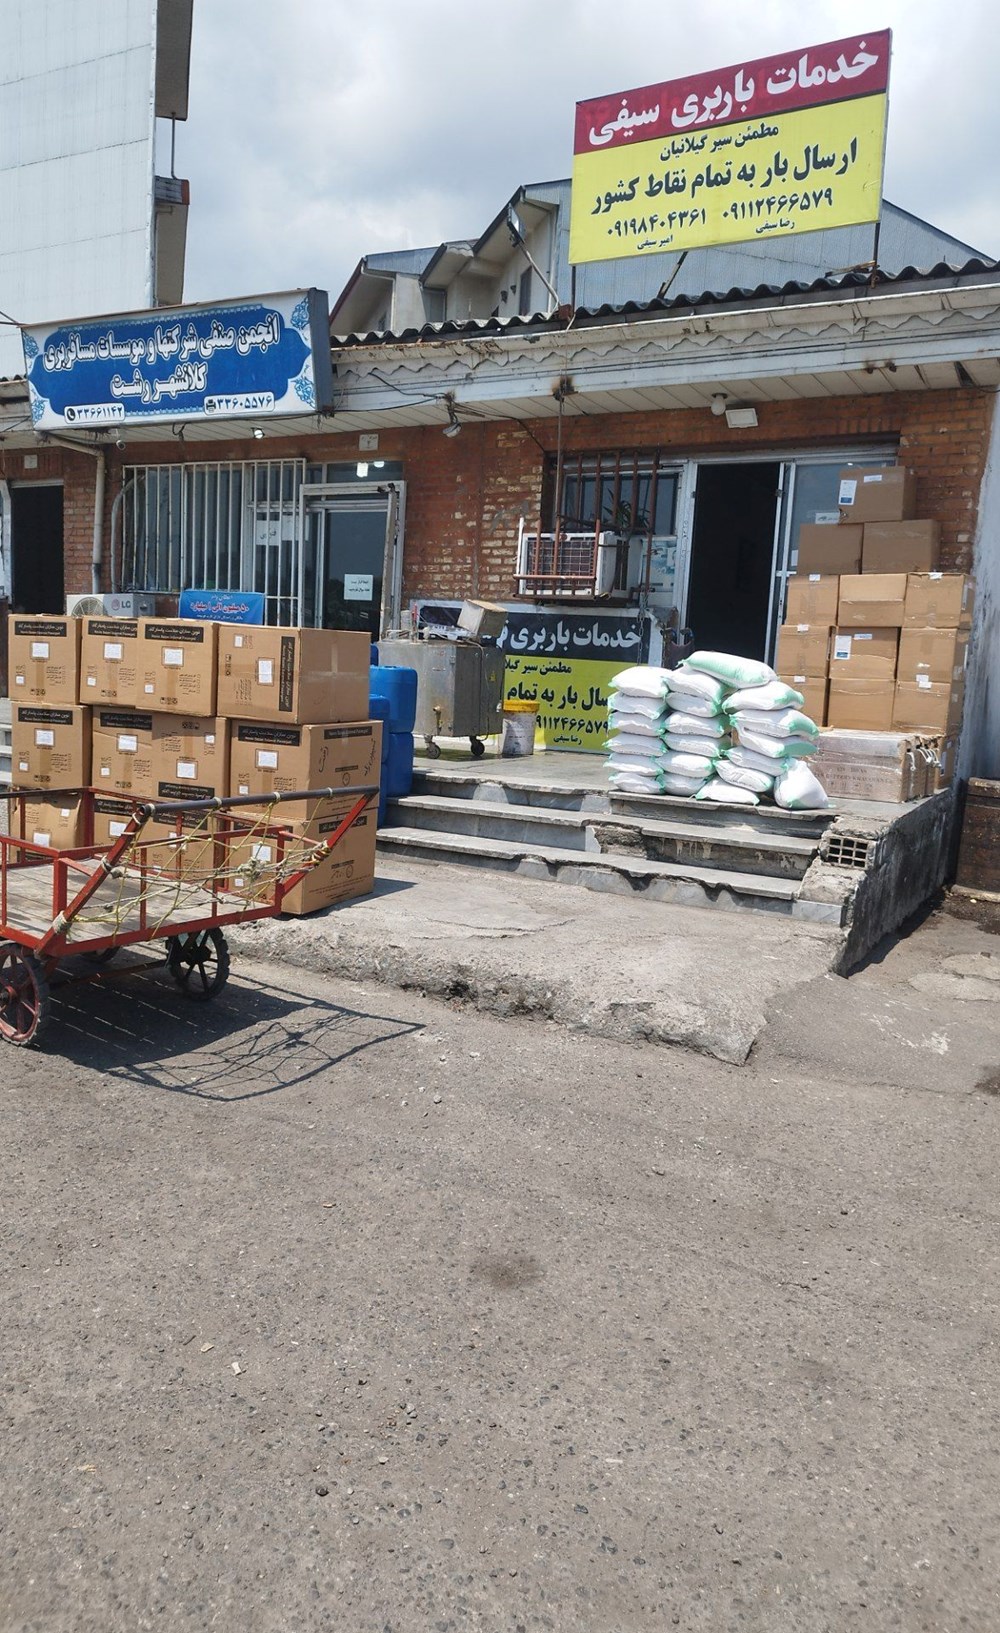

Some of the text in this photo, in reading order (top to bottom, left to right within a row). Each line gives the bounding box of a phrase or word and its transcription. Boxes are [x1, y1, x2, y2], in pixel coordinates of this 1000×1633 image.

[589, 41, 879, 145] خدمات باربری سیفی
[659, 122, 779, 161] مطمئن سیر گیلانیان
[591, 138, 857, 215] ارسال بار به تمام نقاط کشور
[722, 188, 832, 219] ۰۹۱۱۲۴۶۶۵۷۹
[607, 209, 706, 237] ۰۹۱۹۸۴۰۴۳۶۱
[755, 217, 796, 233] رضا سیفی
[97, 330, 145, 365] موسسات
[200, 320, 235, 359] صنفی
[238, 314, 280, 354] انجمن
[147, 343, 156, 364] و
[110, 362, 208, 403] کلانشهر رشت
[510, 621, 570, 652] باربری
[572, 623, 641, 648] خدمات
[521, 664, 538, 674] سیر
[540, 661, 572, 675] مطمئن
[507, 682, 538, 700] تمام
[541, 687, 554, 707] به
[557, 685, 578, 710] بار
[536, 715, 608, 734] ۹۱۱۲۴۶۶۵۷۹
